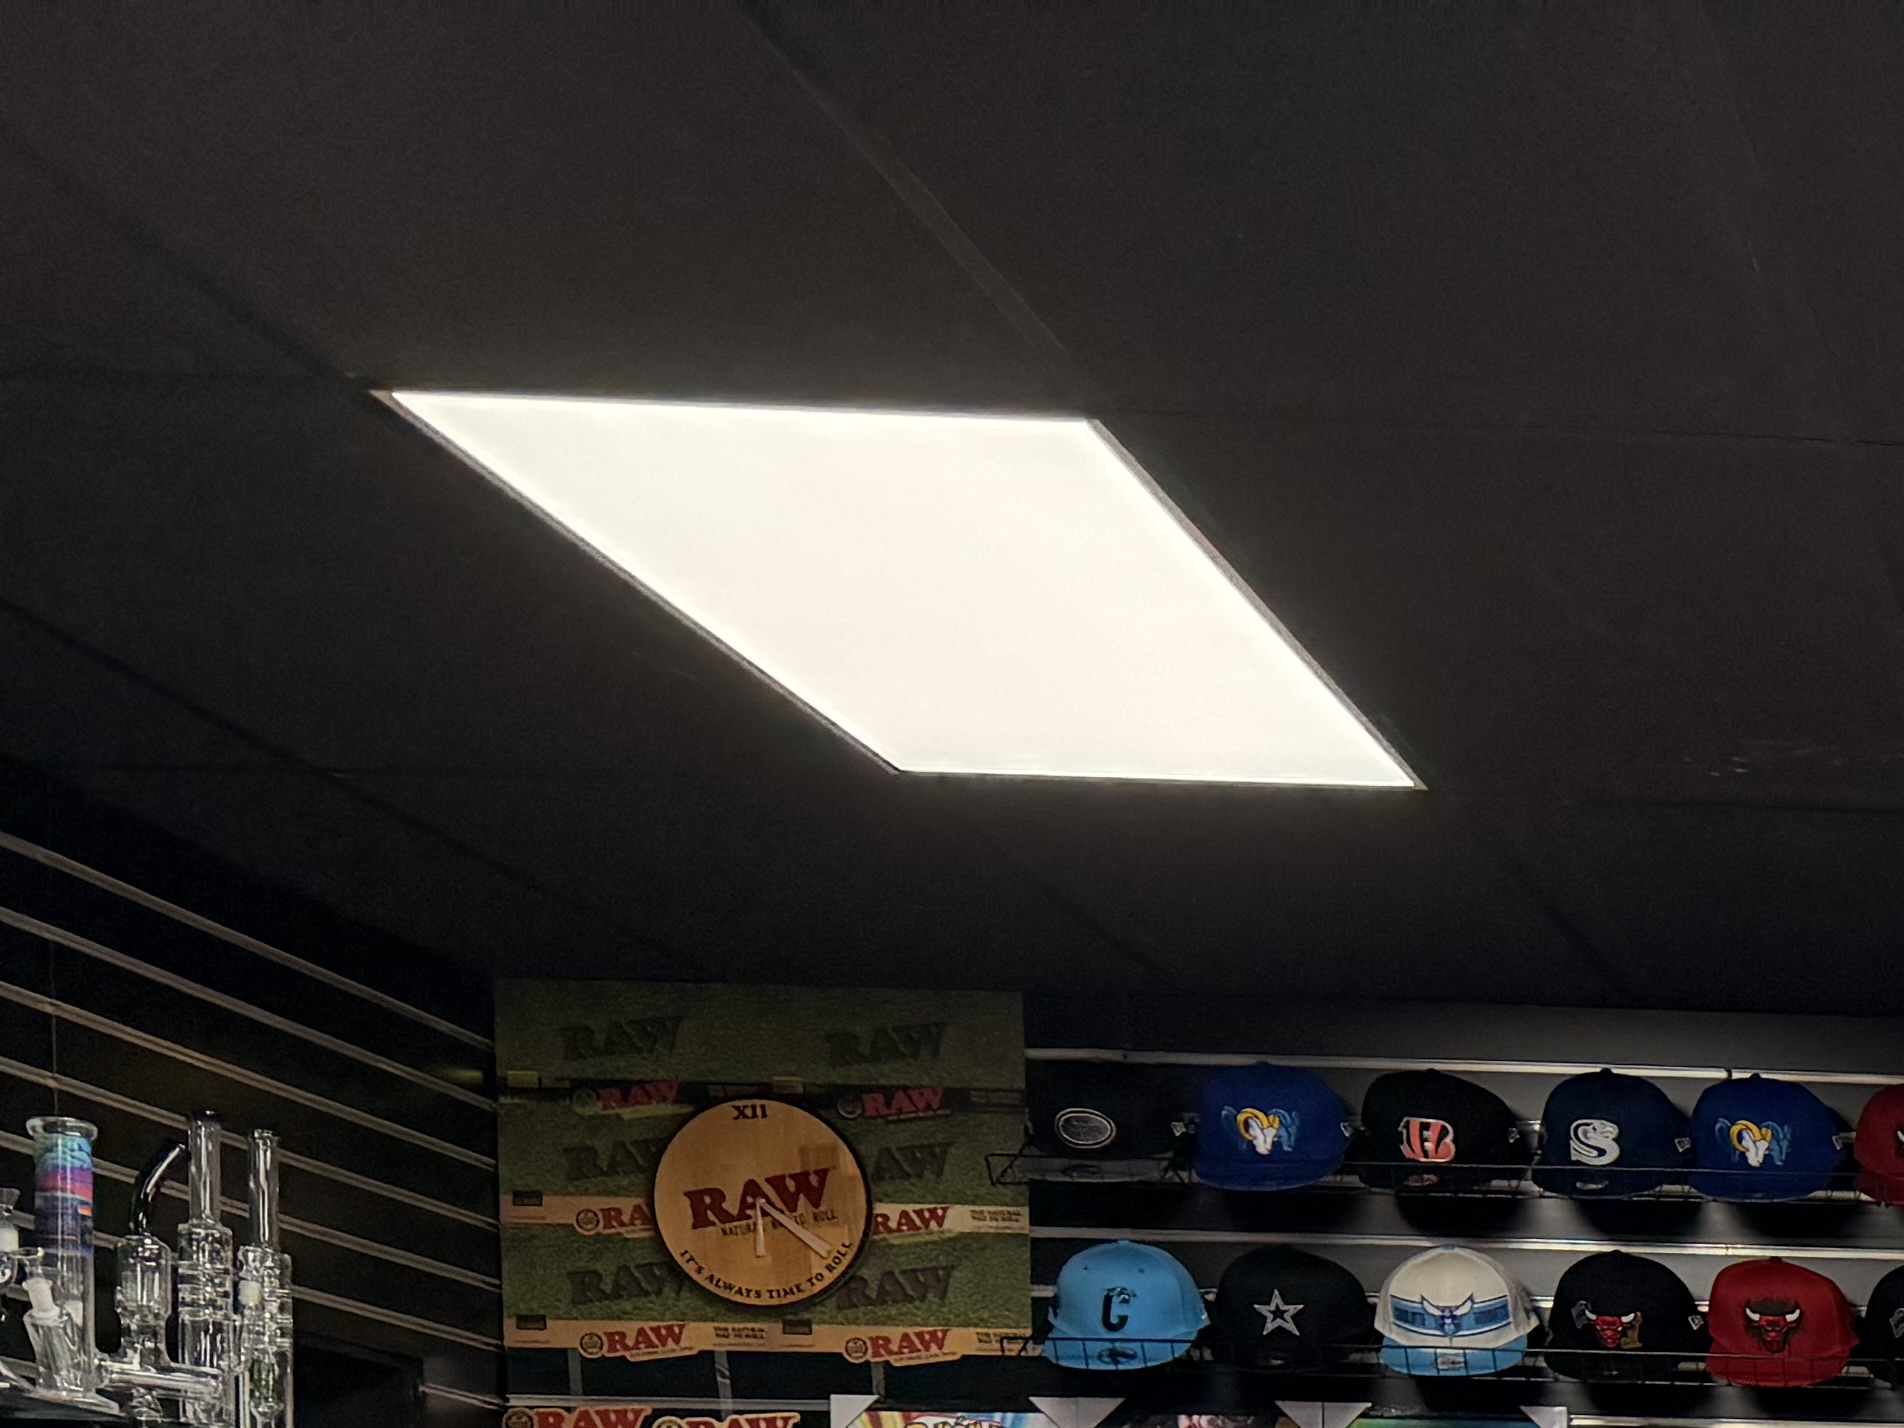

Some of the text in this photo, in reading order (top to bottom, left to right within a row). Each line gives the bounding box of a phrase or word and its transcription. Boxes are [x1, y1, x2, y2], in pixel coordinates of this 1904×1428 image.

[561, 1015, 684, 1062] RAW
[731, 1103, 768, 1120] XII
[683, 1167, 831, 1231] RAW
[680, 1242, 852, 1300] IT'S ALWAYS TIME TO ROLL
[602, 1323, 686, 1353] RAW
